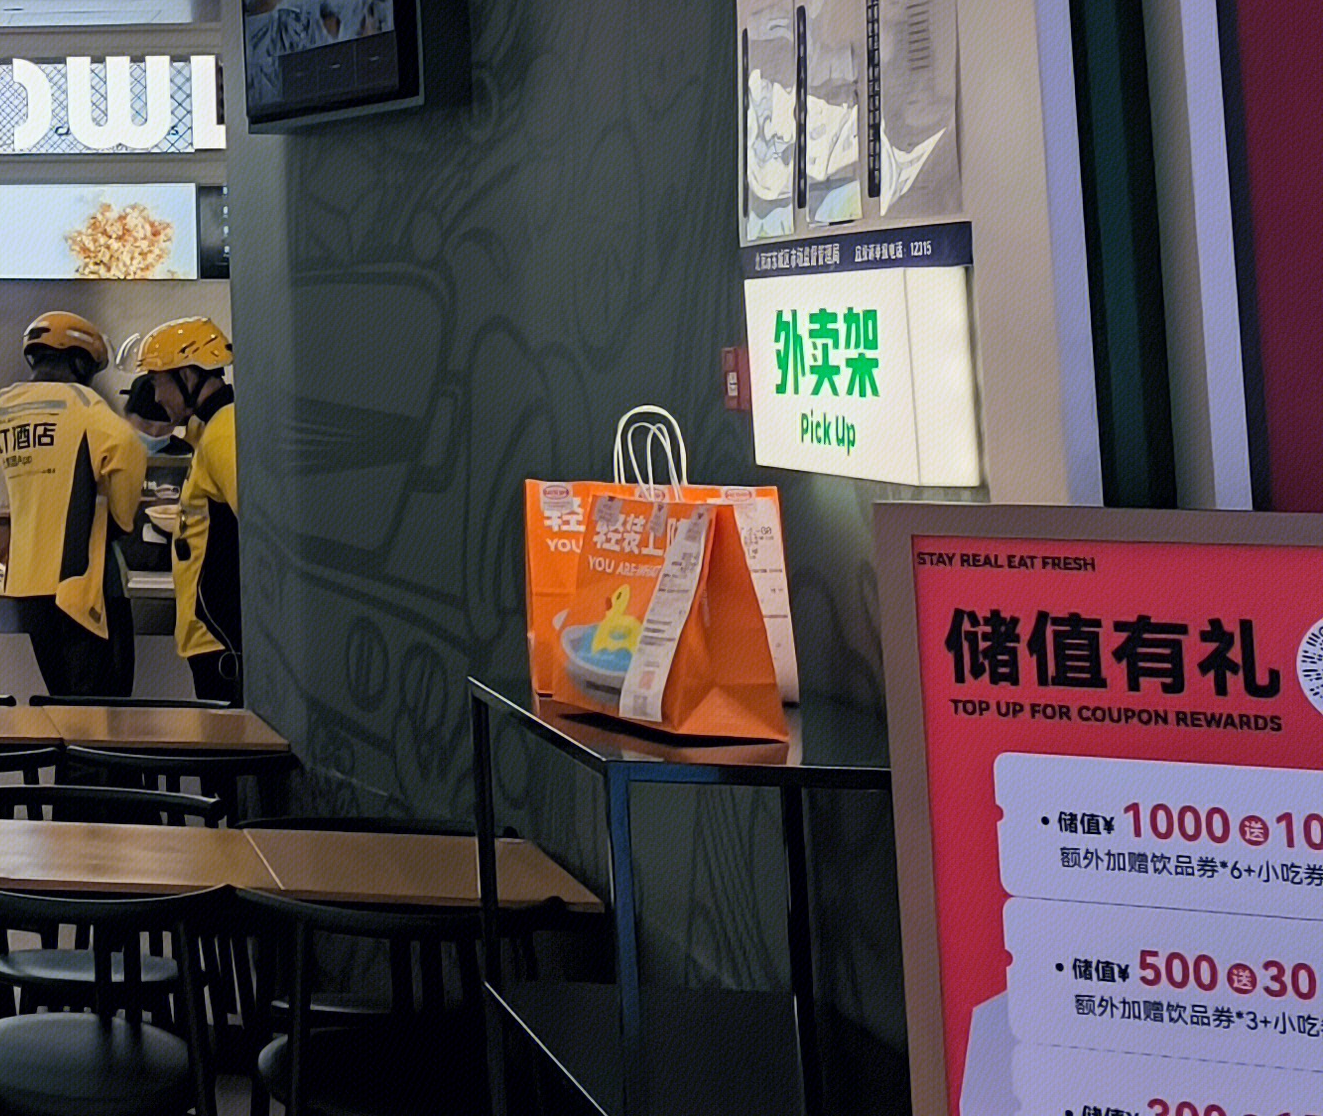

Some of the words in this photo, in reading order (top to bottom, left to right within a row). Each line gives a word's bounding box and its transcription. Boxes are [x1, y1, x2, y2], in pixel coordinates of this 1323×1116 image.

[773, 307, 881, 398] 外卖架
[800, 409, 832, 446] Pick
[835, 415, 856, 455] Up
[917, 551, 956, 566] STAY
[960, 553, 1003, 568] REAL
[1007, 554, 1038, 570] EAT
[1041, 556, 1096, 571] FRESH
[945, 607, 1281, 699] 储值有礼
[949, 699, 990, 716] TOP
[996, 700, 1024, 719] UP
[1030, 703, 1072, 721] FOR
[1077, 706, 1169, 725] COUPON
[1175, 710, 1283, 732] REWARDS
[1123, 802, 1231, 844] 1000
[1139, 949, 1218, 992] 500
[1074, 994, 1323, 1038] 额外加赠饮品券3+小吃
